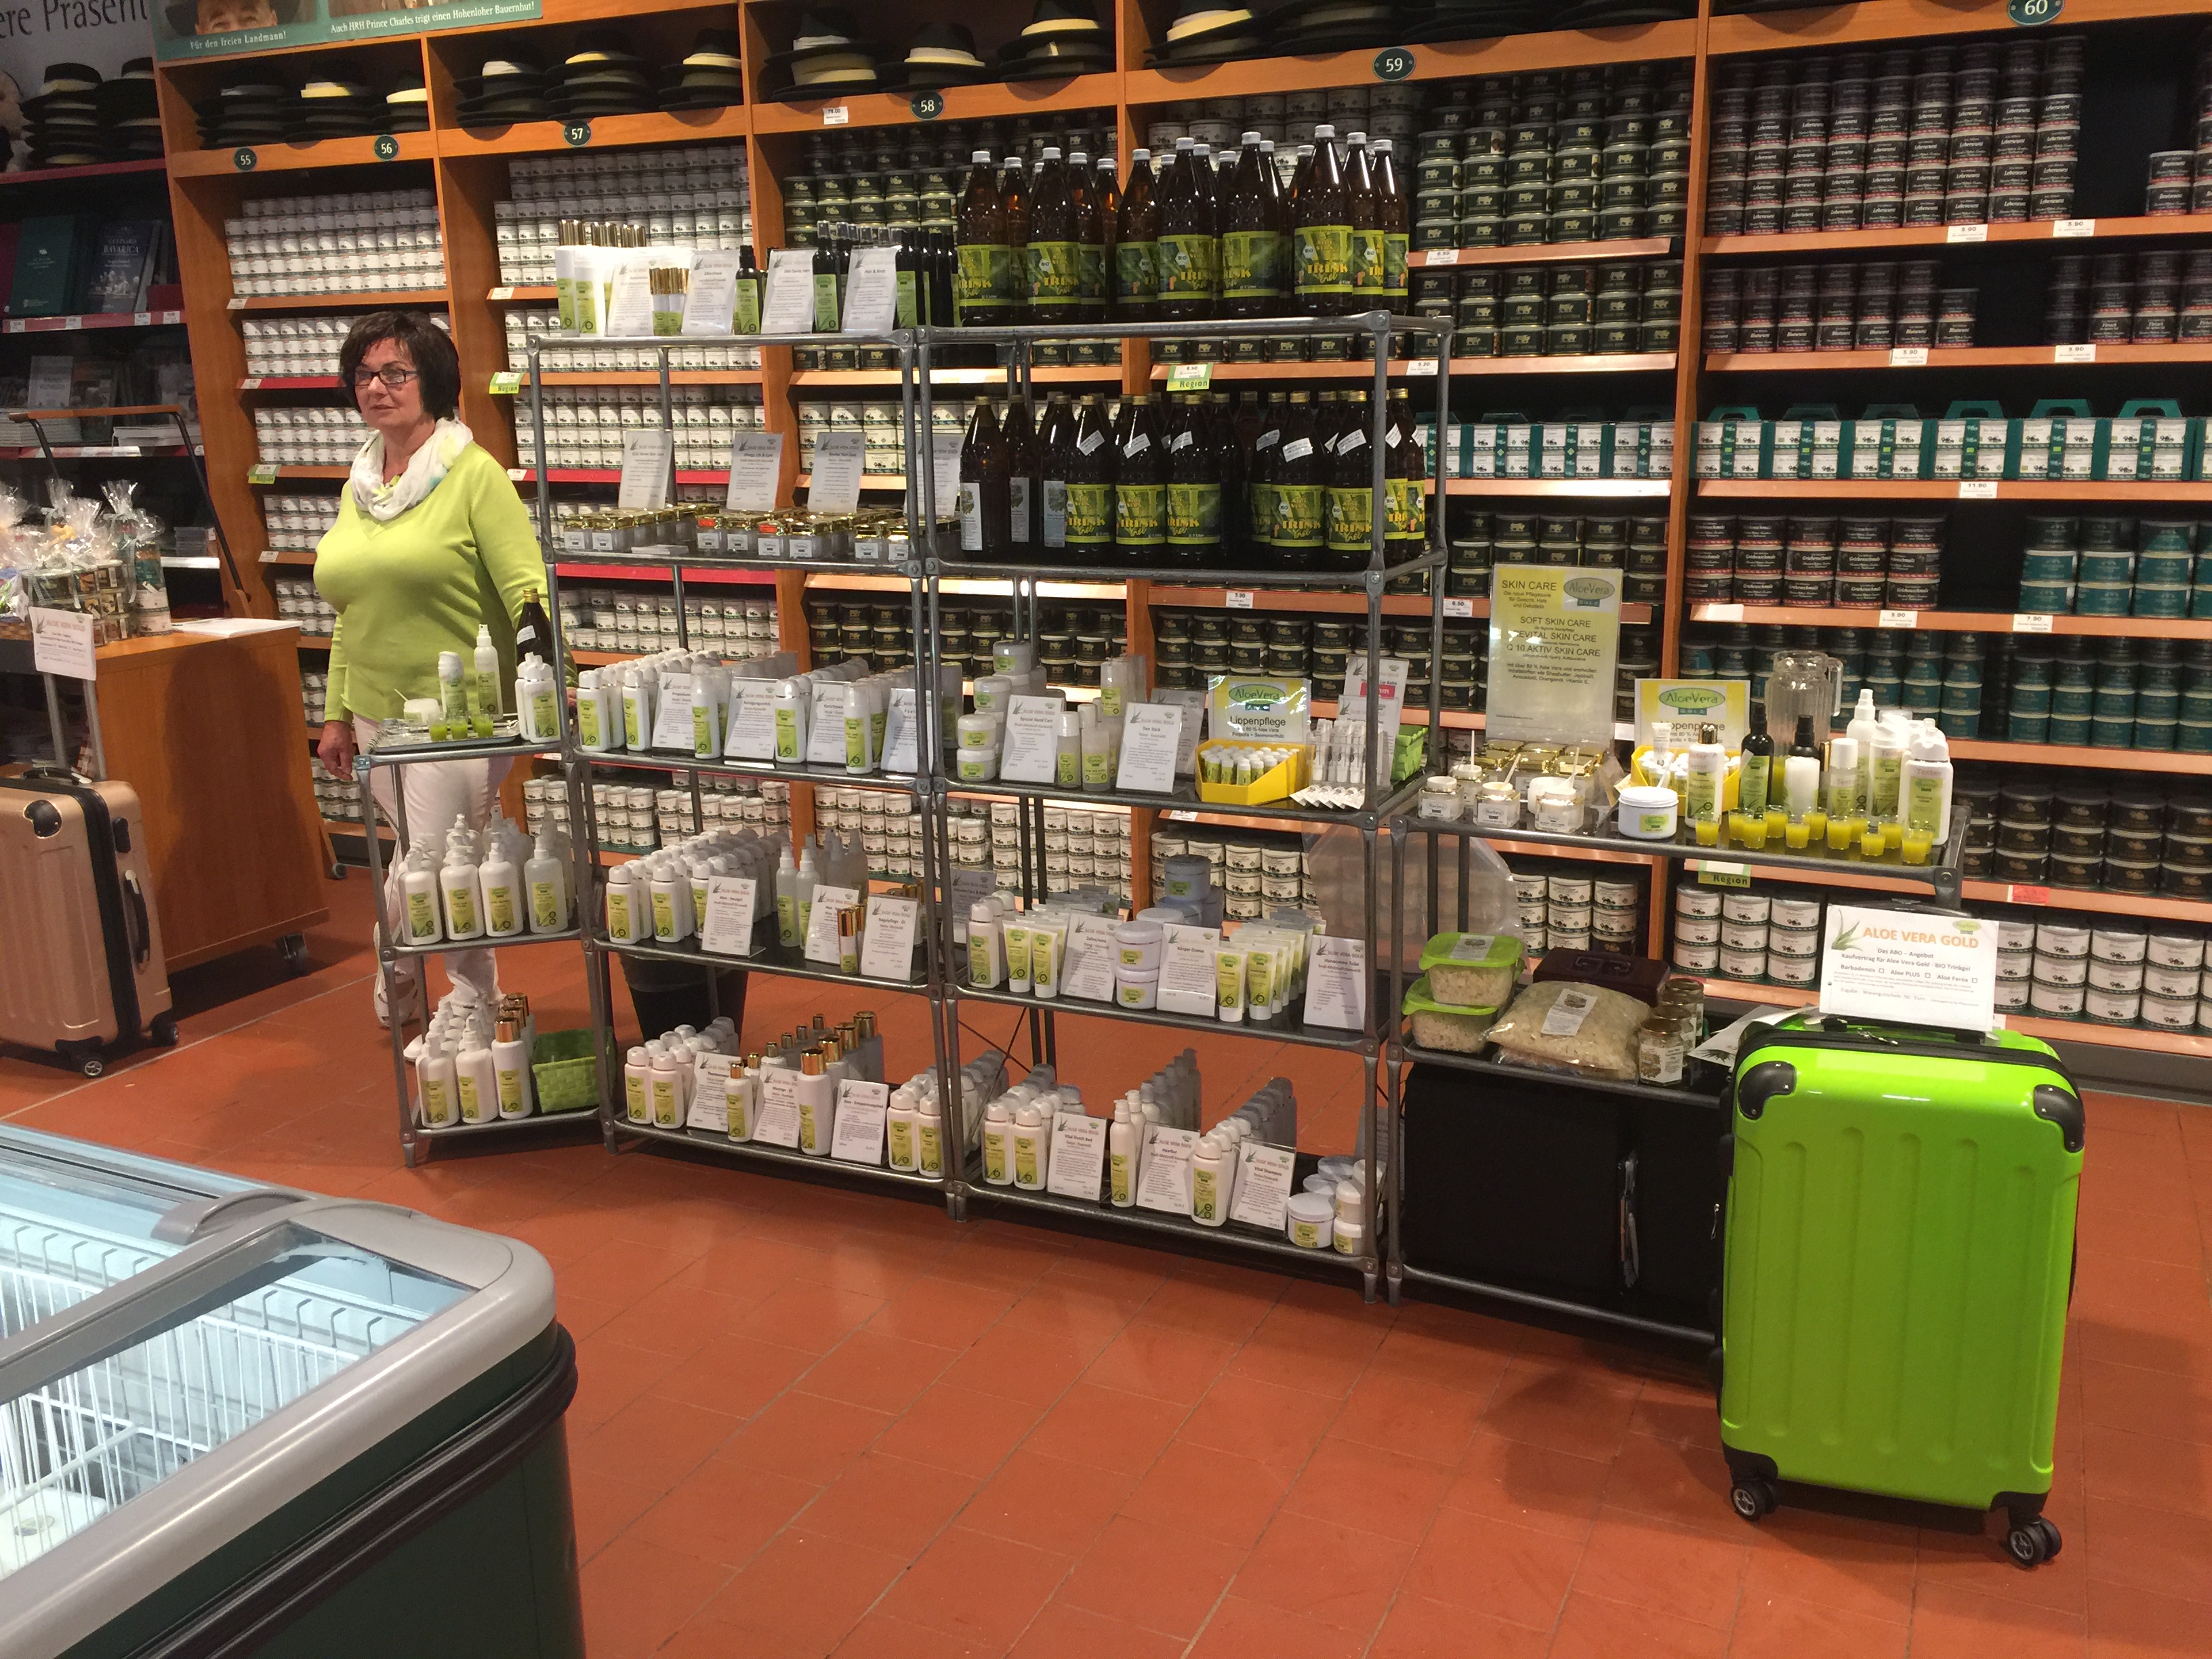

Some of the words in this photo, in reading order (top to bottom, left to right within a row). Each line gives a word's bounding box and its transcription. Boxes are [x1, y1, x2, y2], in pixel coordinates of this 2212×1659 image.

[2024, 0, 2048, 15] 60
[331, 24, 347, 34] Auch
[349, 20, 365, 30] HRH
[366, 18, 388, 28] Prince
[389, 16, 413, 26] Charles
[415, 14, 430, 24] trägt
[432, 12, 451, 21] einen
[453, 8, 493, 19] Hohenloher
[495, 1, 534, 14] Bauernhut!
[190, 40, 202, 50] Für
[205, 39, 218, 47] den
[220, 36, 241, 47] freien
[245, 30, 286, 44] Landmann!
[1385, 58, 1404, 73] 59
[920, 100, 935, 112] 58
[571, 127, 583, 140] 57
[381, 142, 393, 155] 56
[239, 154, 251, 166] 55
[1179, 379, 1208, 390] Region
[1502, 580, 1525, 589] SKIN
[1528, 581, 1557, 591] CARE
[1569, 582, 1610, 594] AloeVera
[1545, 617, 1565, 626] SKIN
[1567, 619, 1591, 628] CARE
[1551, 632, 1570, 640] SKIN
[1572, 634, 1597, 642] CARE
[1527, 645, 1552, 653] AKTIV
[1554, 647, 1574, 655] SKIN
[1576, 649, 1601, 657] CARE
[1235, 689, 1279, 699] AloeVera
[1666, 693, 1718, 703] AloeVera
[1230, 716, 1286, 728] Lippenpflege
[1713, 874, 1748, 885] Region
[1864, 927, 1898, 940] ALOE
[1901, 930, 1936, 944] VERA
[1941, 935, 1979, 948] GOLD
[1841, 954, 1875, 962] Kaufvertrag
[1841, 964, 1875, 972] Barbadensis
